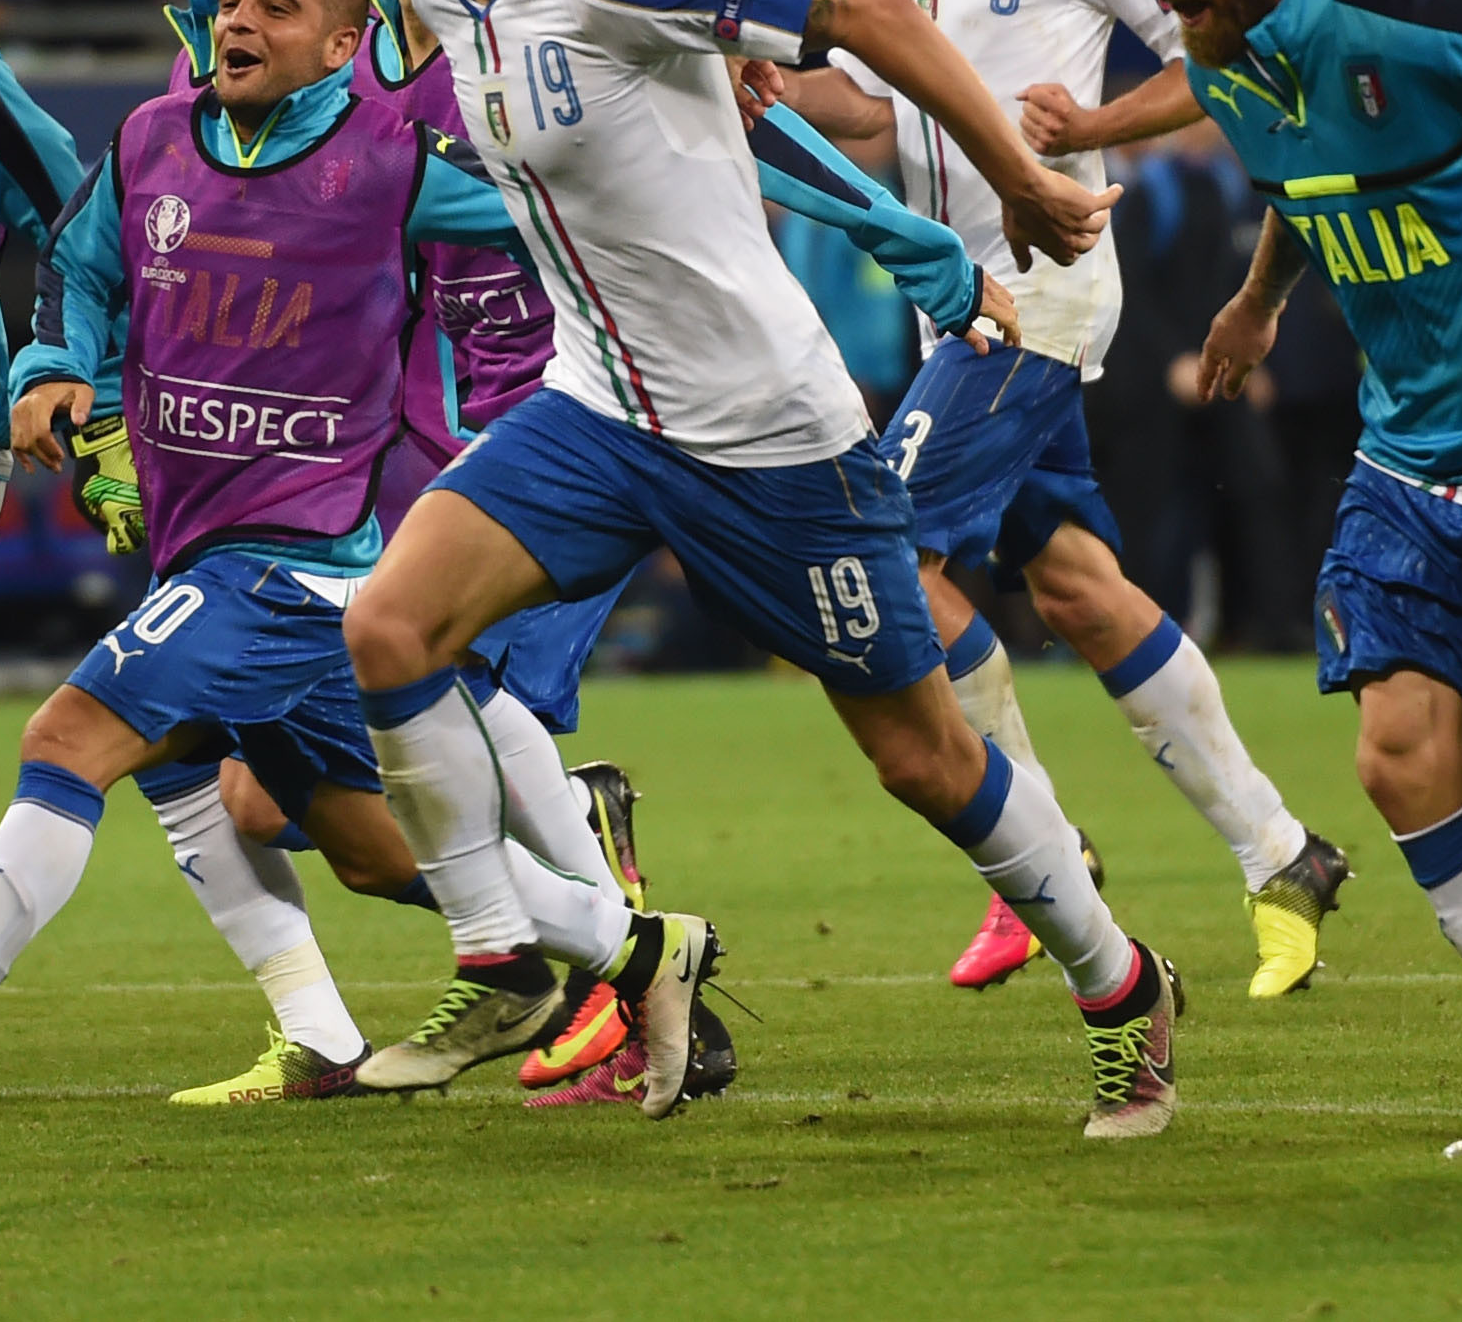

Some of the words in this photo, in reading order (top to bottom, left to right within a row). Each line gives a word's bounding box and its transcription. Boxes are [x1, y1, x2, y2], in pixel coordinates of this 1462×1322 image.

[524, 40, 583, 131] 19
[158, 391, 344, 447] RESPECT
[887, 410, 933, 482] 3
[807, 556, 880, 644] 19
